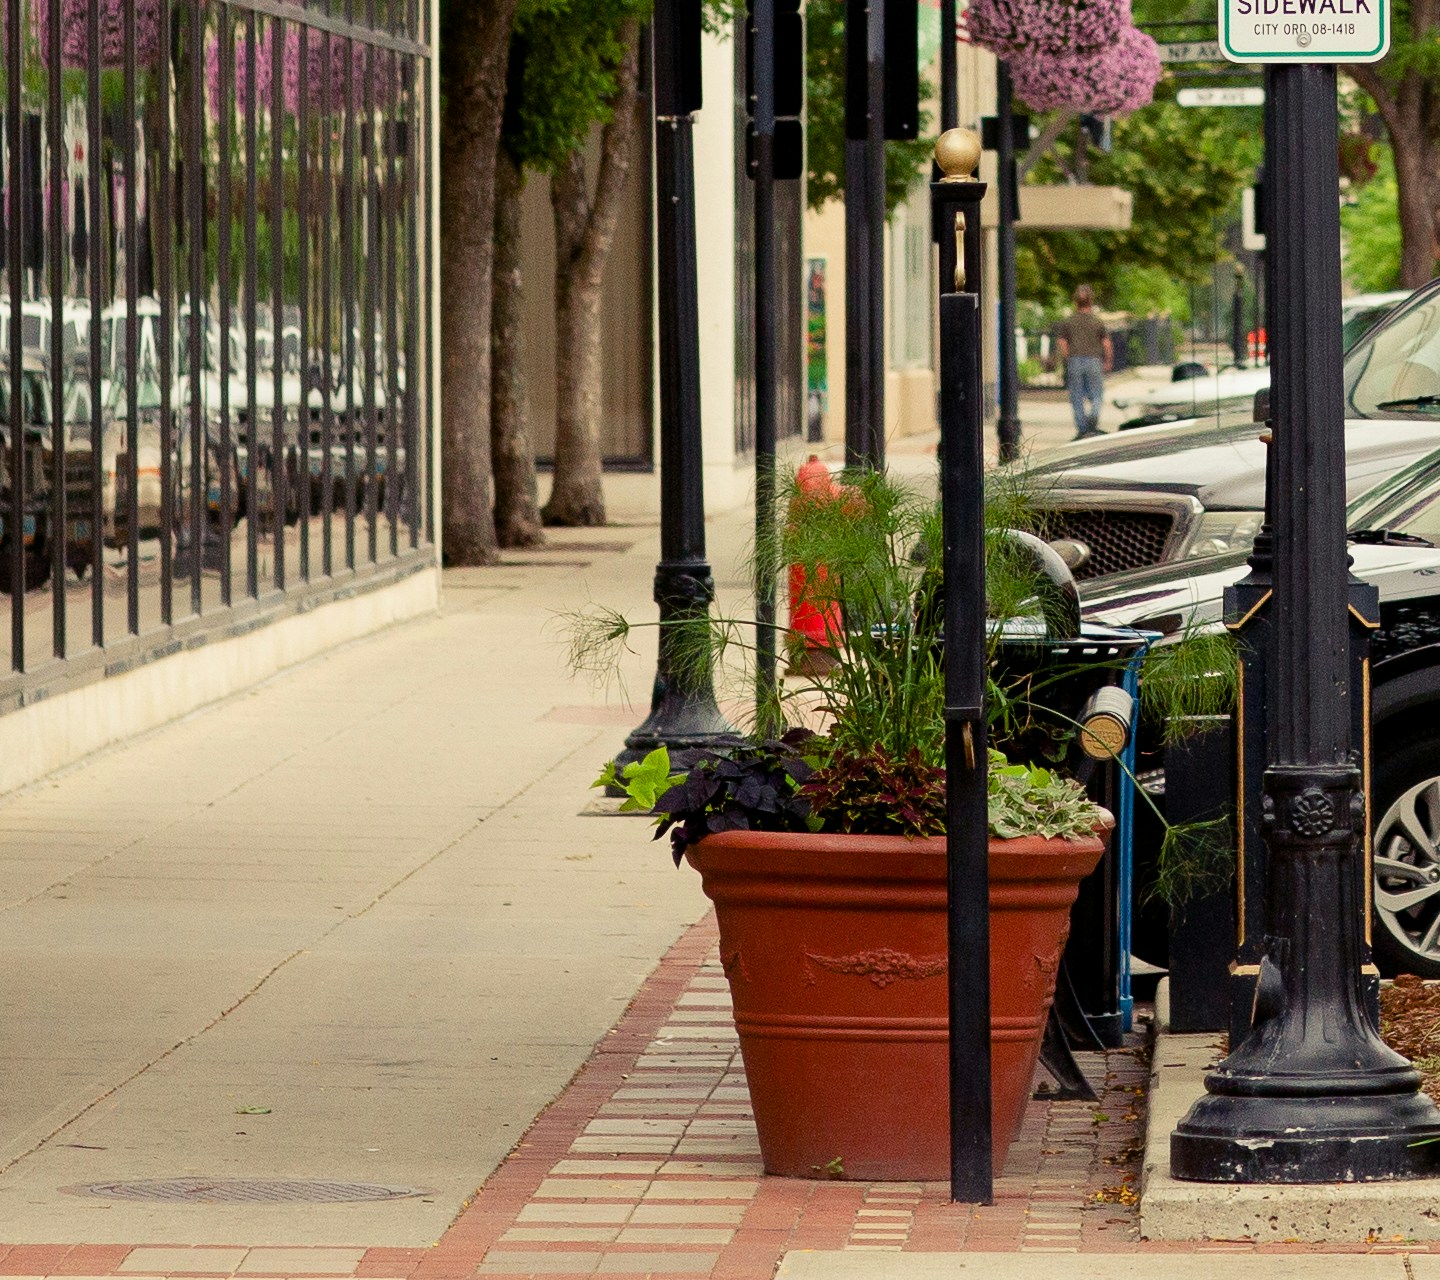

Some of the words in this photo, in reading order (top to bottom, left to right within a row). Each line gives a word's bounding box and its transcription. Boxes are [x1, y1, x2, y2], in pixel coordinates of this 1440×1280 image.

[1254, 23, 1279, 35] CITY
[1312, 23, 1356, 35] 08-1418
[1198, 45, 1220, 57] AV
